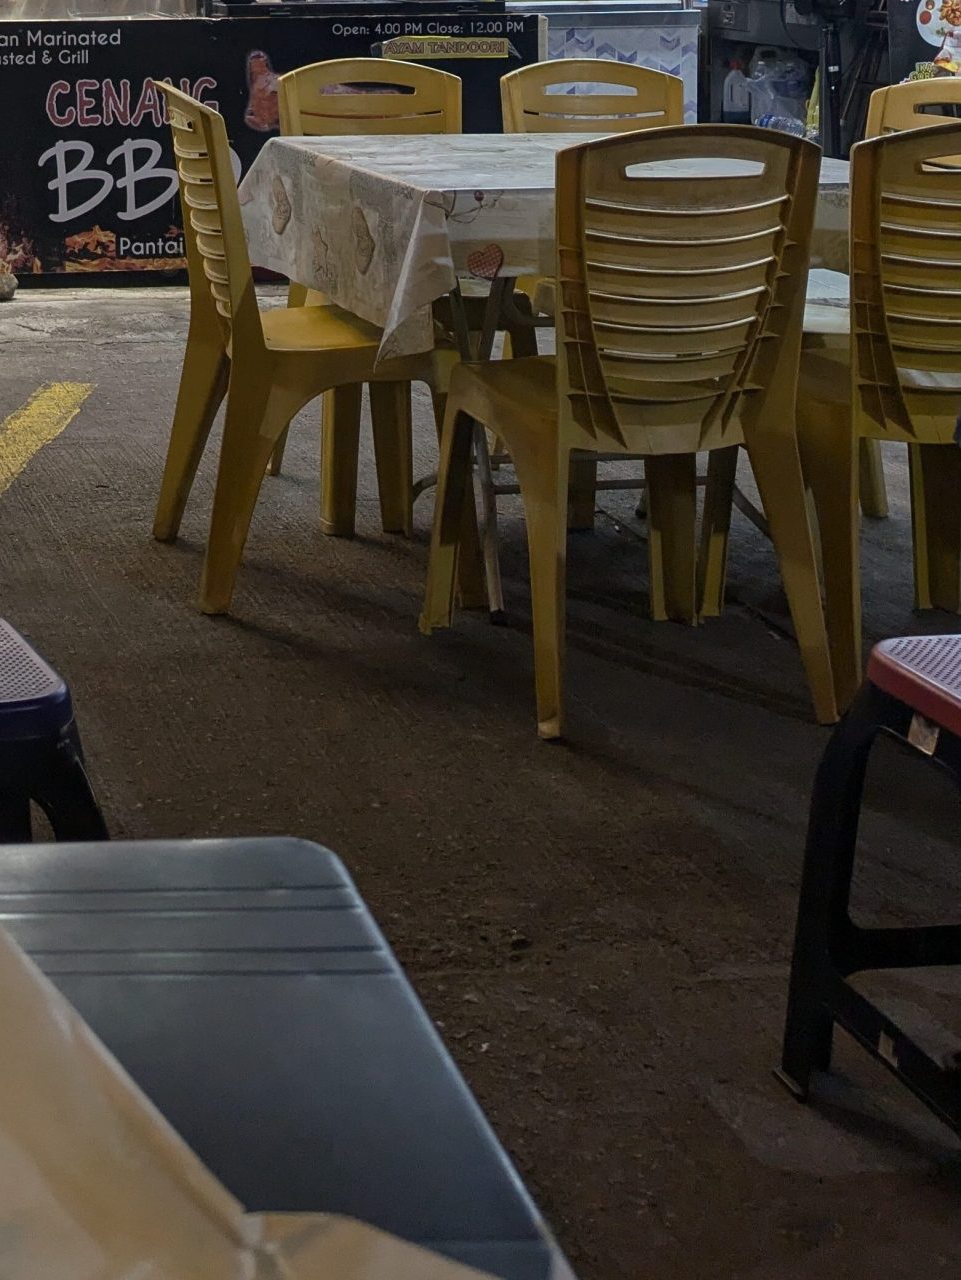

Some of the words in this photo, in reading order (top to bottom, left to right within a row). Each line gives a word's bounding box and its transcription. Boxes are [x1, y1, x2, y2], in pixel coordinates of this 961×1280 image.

[332, 24, 370, 36] Open:
[374, 23, 401, 34] 4.00
[404, 23, 422, 34] PM
[426, 22, 464, 34] Close:
[470, 22, 503, 33] 12.00
[506, 22, 524, 33] PM
[26, 28, 121, 46] Marinated
[383, 42, 425, 54] AYAM
[428, 41, 505, 53] TANDOORI
[41, 51, 53, 65] &
[58, 50, 89, 65] Grill
[120, 237, 184, 255] Pantai
